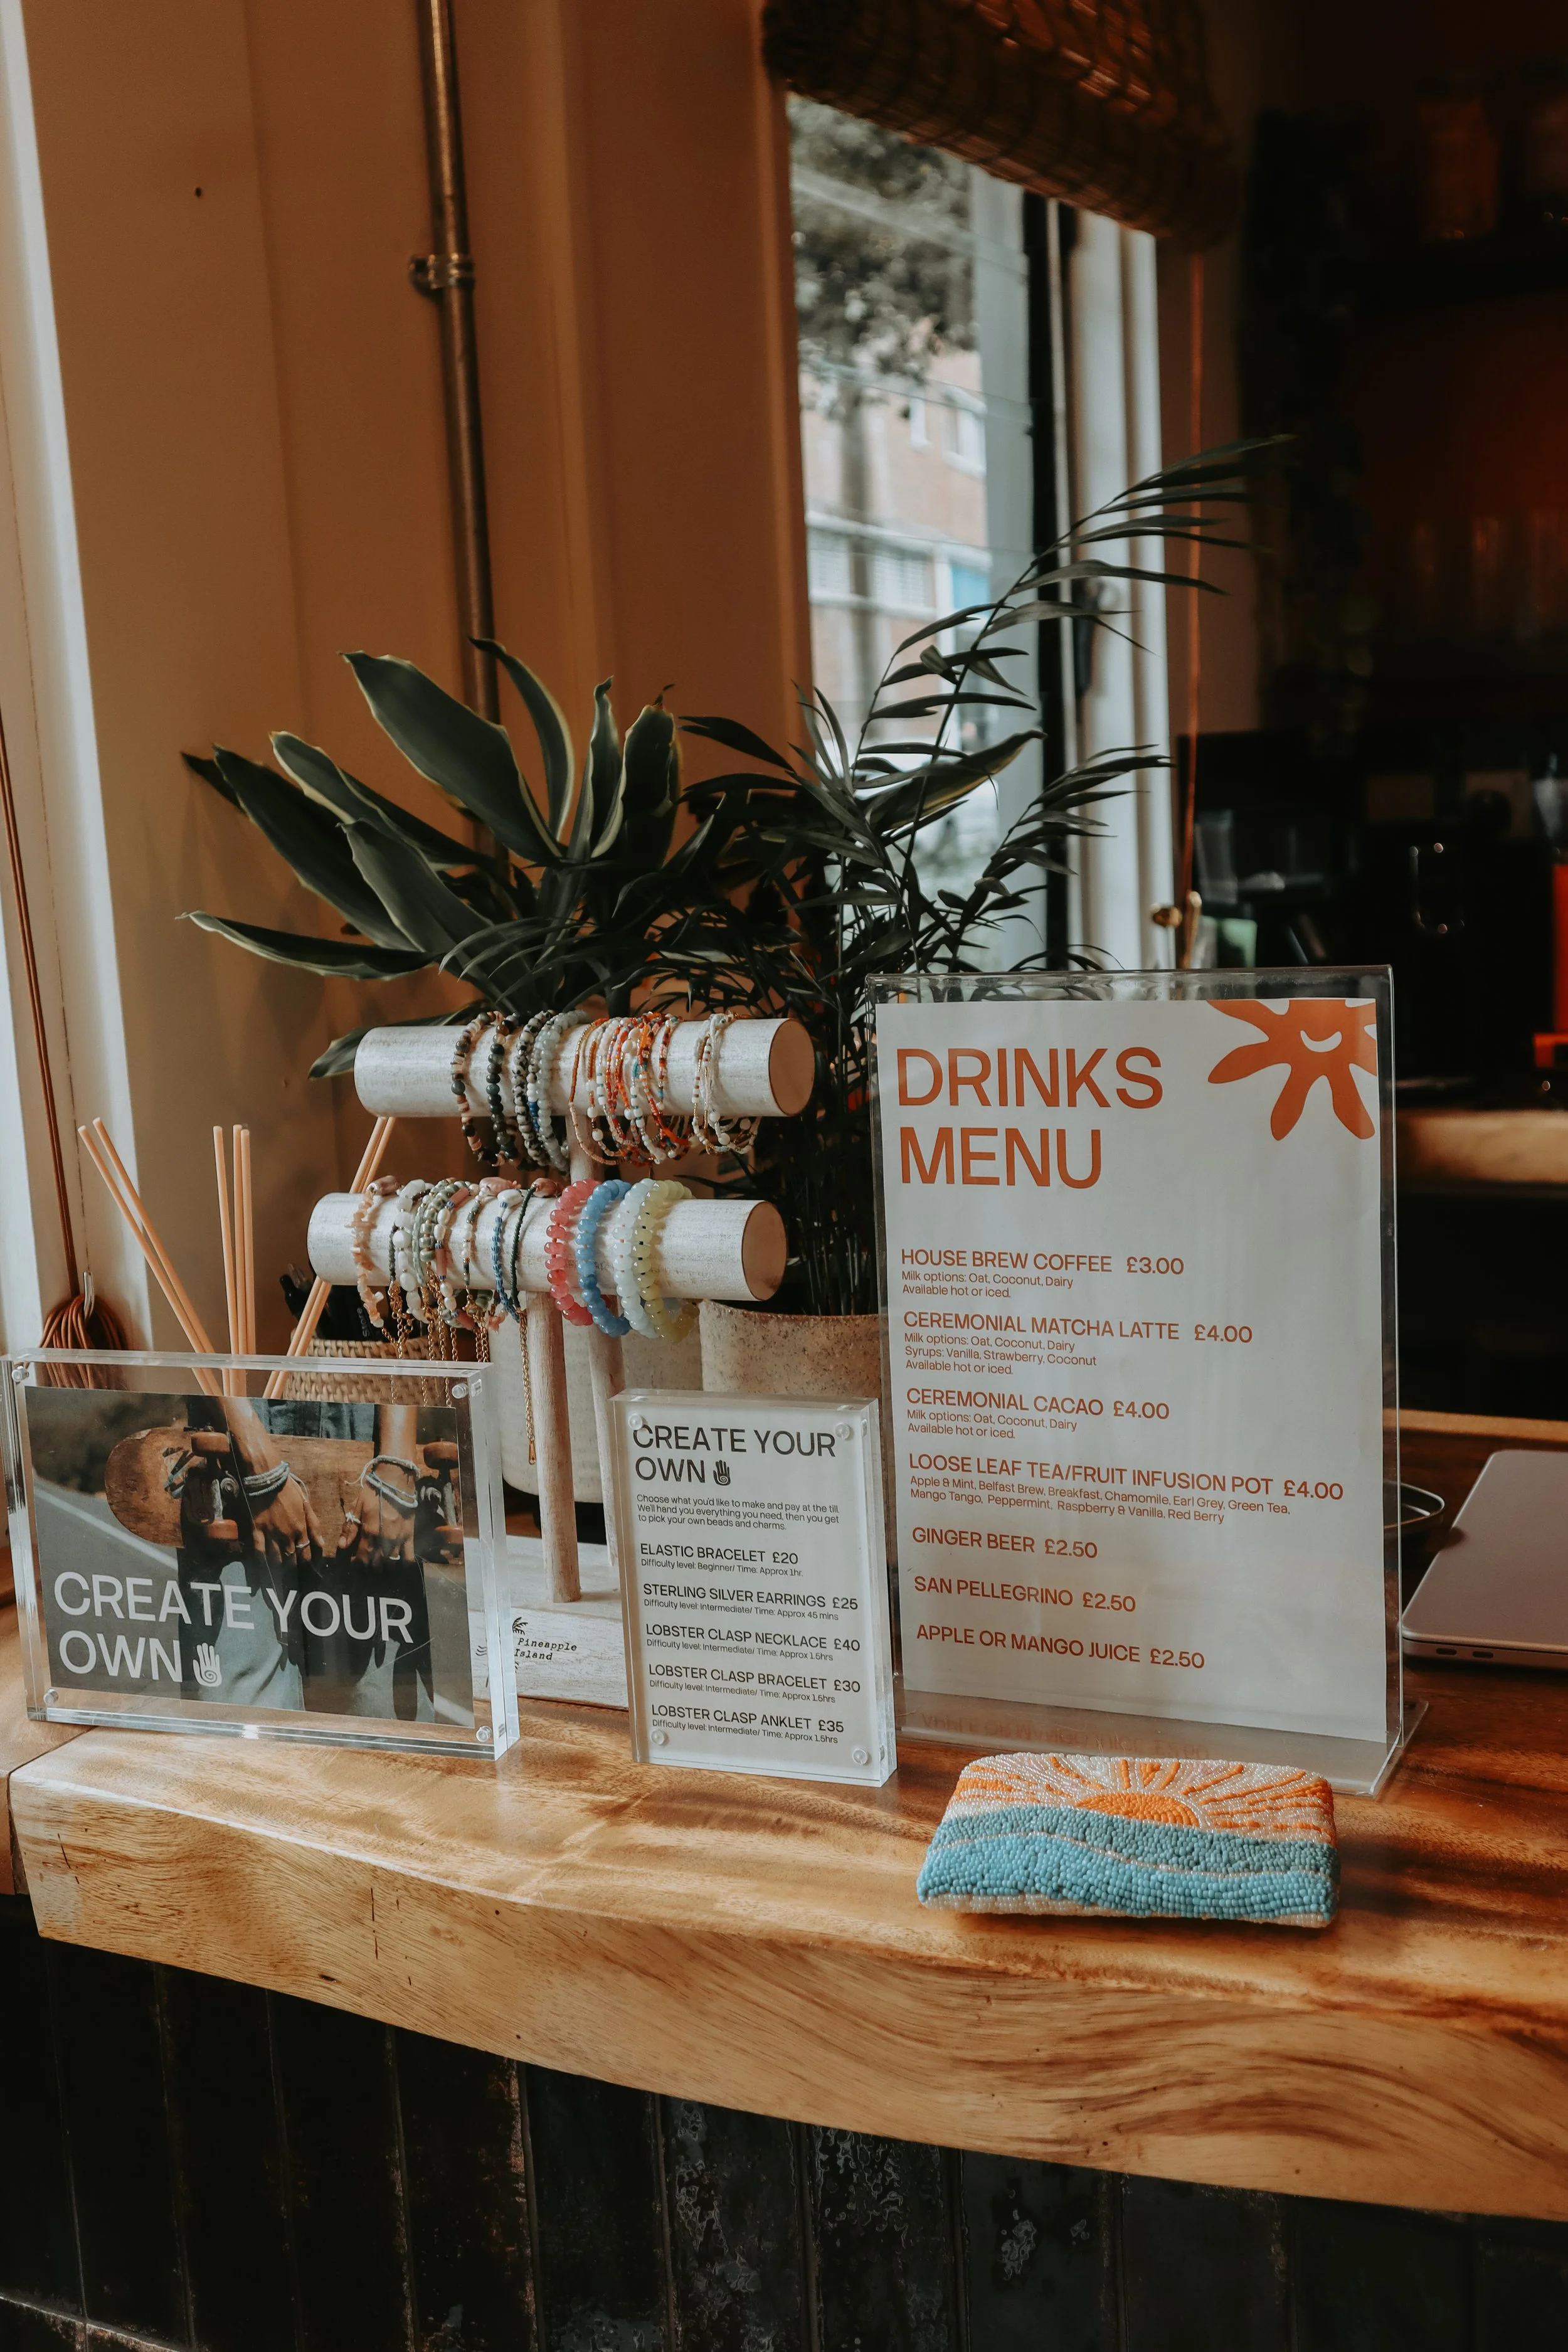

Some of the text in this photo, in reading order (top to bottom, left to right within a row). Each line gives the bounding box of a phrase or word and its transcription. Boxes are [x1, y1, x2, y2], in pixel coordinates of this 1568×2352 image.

[897, 1047, 1163, 1109] DRINKS
[900, 1126, 1101, 1189] MENU
[902, 1249, 1184, 1274] HOUSE BREW COFFEE £3.00
[902, 1270, 1073, 1290] Milk options: Oat, Coconut, Dairy
[903, 1284, 1011, 1298] Available hot or iced.
[904, 1311, 1253, 1343] CEREMONIAL MATCHA LATTE £4.00
[904, 1332, 1075, 1353] Milk options: Oat, Coconut, Dairy
[905, 1345, 1096, 1366] Syrups: Vanilla, Strawberry, Coconut
[906, 1359, 1013, 1375] Available hot or iced.
[907, 1387, 1169, 1419] CEREMONIAL CACAO £4.00
[907, 1409, 1077, 1432] Milk options: Oat, Coconut, Dairy
[633, 1424, 835, 1457] CREATE YOUR
[635, 1456, 705, 1483] OWN
[909, 1453, 1343, 1500] LOOSE LEAF TEA/FRUIT INFUSION POT £4.00
[637, 1494, 669, 1503] Choose
[671, 1496, 691, 1505] what
[692, 1498, 714, 1507] you'd
[716, 1498, 730, 1507] like
[731, 1500, 740, 1508] to
[742, 1500, 765, 1509] make
[767, 1502, 783, 1510] and
[785, 1504, 800, 1513] pay
[813, 1504, 827, 1513] the
[829, 1505, 839, 1513] till.
[911, 1475, 1290, 1515] Apple & Mint, Belfast Brew, Breakfast, Chamomile, Earl Grey, Green Tea,
[911, 1488, 1224, 1525] Mango Tango, Peppermint, Raspberry & Vanilla, Red Berry
[637, 1504, 839, 1525] We'll hand you everything you need, then you get
[649, 1514, 666, 1523] pick
[667, 1517, 686, 1525] your
[706, 1517, 733, 1527] beads
[735, 1520, 751, 1528] and
[753, 1520, 787, 1530] charms.
[640, 1543, 798, 1564] ELASTIC BRACELET £20
[912, 1527, 1098, 1558] GINGER BEER £2.50
[641, 1559, 675, 1569] Difficulty
[676, 1560, 696, 1569] level:
[697, 1562, 735, 1572] Beginner/
[736, 1565, 758, 1573] Time:
[760, 1567, 788, 1576] Approx
[54, 1572, 413, 1643] CREATE YOUR
[644, 1583, 858, 1610] STERLING SILVER EARRINGS £25
[914, 1576, 1136, 1612] SAN PELLEGRINO £2.50
[644, 1599, 678, 1610] Difficulty
[679, 1601, 699, 1609] level:
[700, 1603, 753, 1614] Intermediate/
[754, 1607, 775, 1616] Time:
[777, 1609, 805, 1618] Approx
[819, 1612, 839, 1621] mins
[517, 1638, 577, 1651] Pineapple
[646, 1623, 861, 1651] LOBSTER CLASP NECKLACE £40
[647, 1638, 681, 1650] Difficulty
[682, 1641, 701, 1650] level:
[702, 1643, 755, 1655] Intermediate/
[756, 1648, 778, 1656] Time:
[780, 1650, 808, 1660] Approx
[917, 1624, 1205, 1669] APPLE OR MANGO JUICE £2.50
[60, 1630, 183, 1682] OWN
[514, 1648, 553, 1660] Island
[649, 1664, 861, 1693] LOBSTER CLASP BRACELET £30
[652, 1704, 844, 1732] LOBSTER CLASP ANKLET £35
